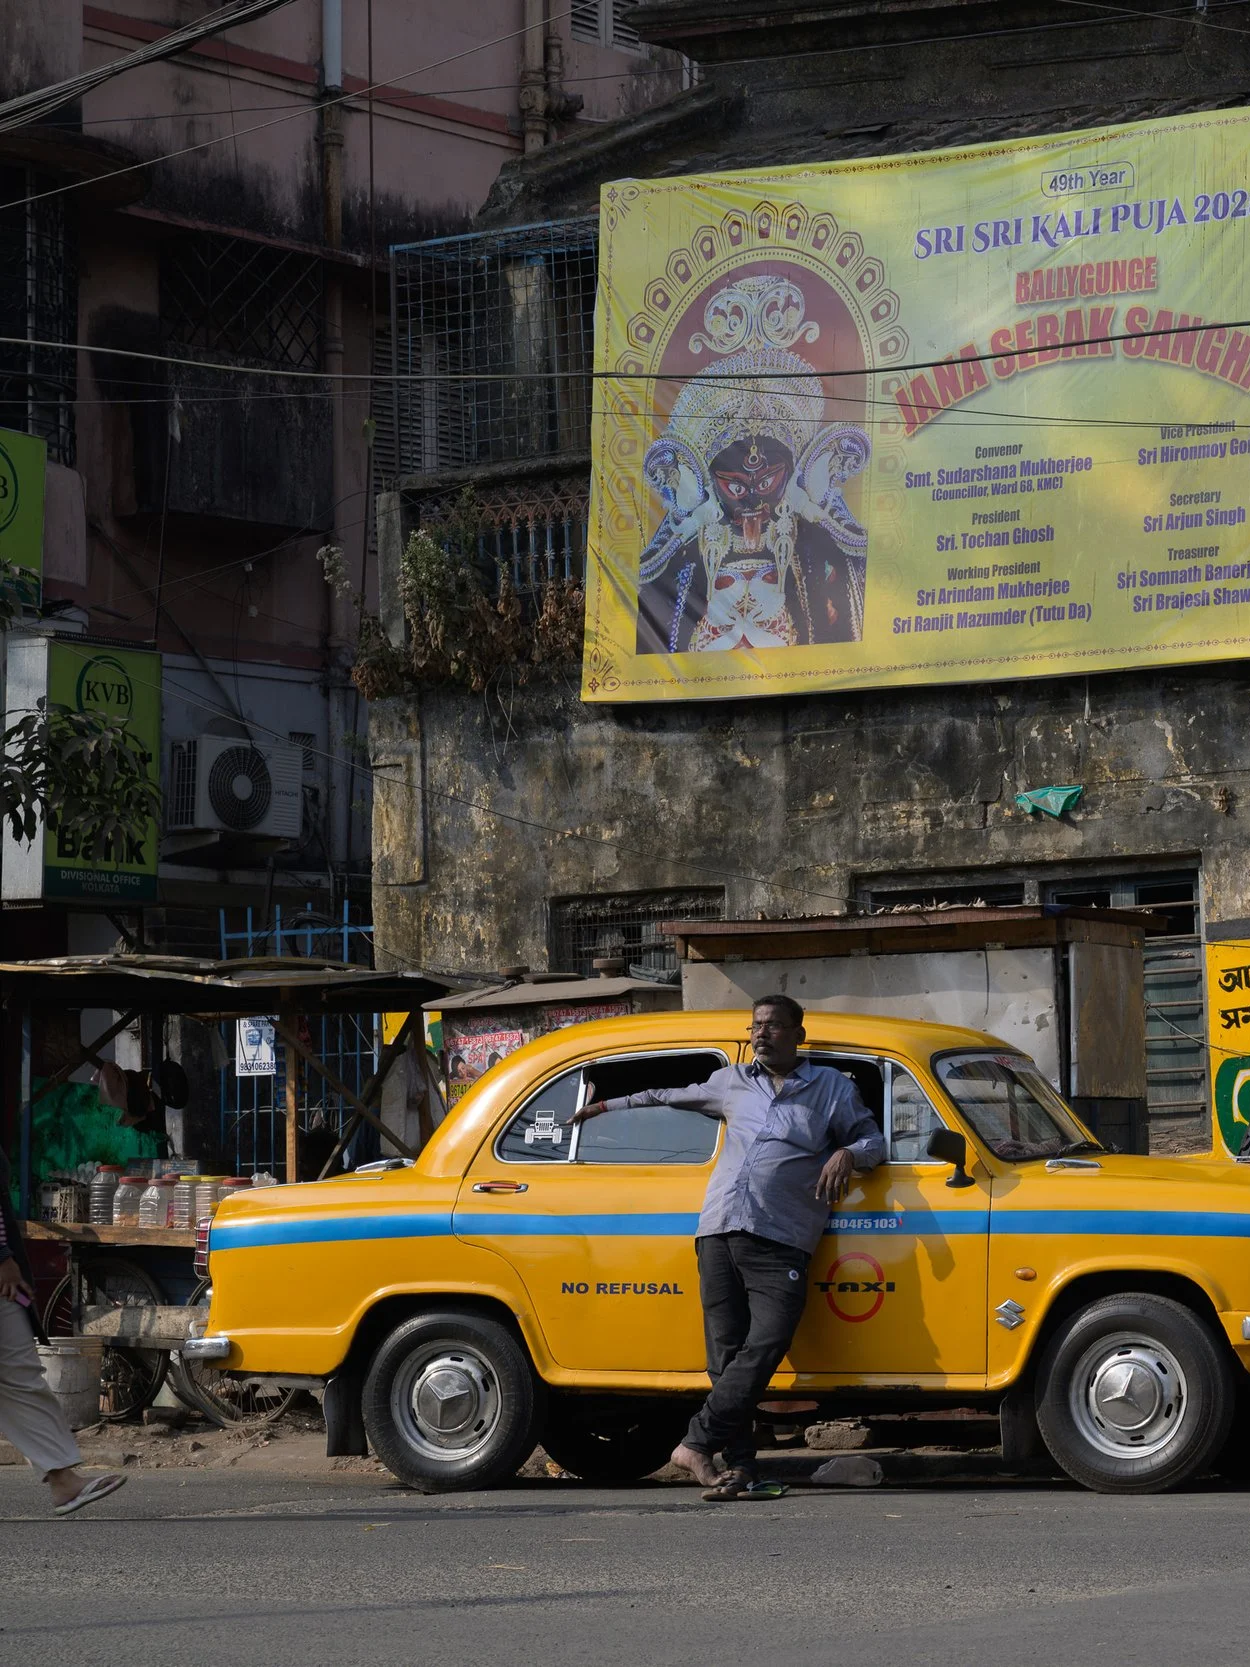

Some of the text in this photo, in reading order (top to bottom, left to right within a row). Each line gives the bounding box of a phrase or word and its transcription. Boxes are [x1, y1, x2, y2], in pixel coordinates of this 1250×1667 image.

[1049, 168, 1128, 192] 49th Year
[915, 227, 965, 259] SRI
[972, 222, 1023, 255] SRI
[1031, 212, 1101, 251] KALI
[1110, 198, 1186, 235] PUJA
[1016, 257, 1157, 304] BALLYGUNGE
[894, 342, 989, 437] JANA
[989, 304, 1117, 378] SEBAK
[975, 443, 1023, 459] Convenor
[905, 456, 1092, 489] Smt. Sudarshana Mukherjee
[991, 481, 1017, 495] Ward
[1020, 480, 1035, 494] 68,
[972, 509, 1020, 525] President
[936, 525, 1054, 552] Sri. Tochan Ghosh
[893, 602, 1091, 634] Sri Ranjit Mazumder (Tutu Da)
[86, 681, 130, 705] KVB
[61, 870, 142, 886] DIVISIONAL OFFICE
[825, 1218, 897, 1229] B04F5103
[561, 1282, 683, 1295] NO REFUSAL
[814, 1282, 895, 1292] TAXI
